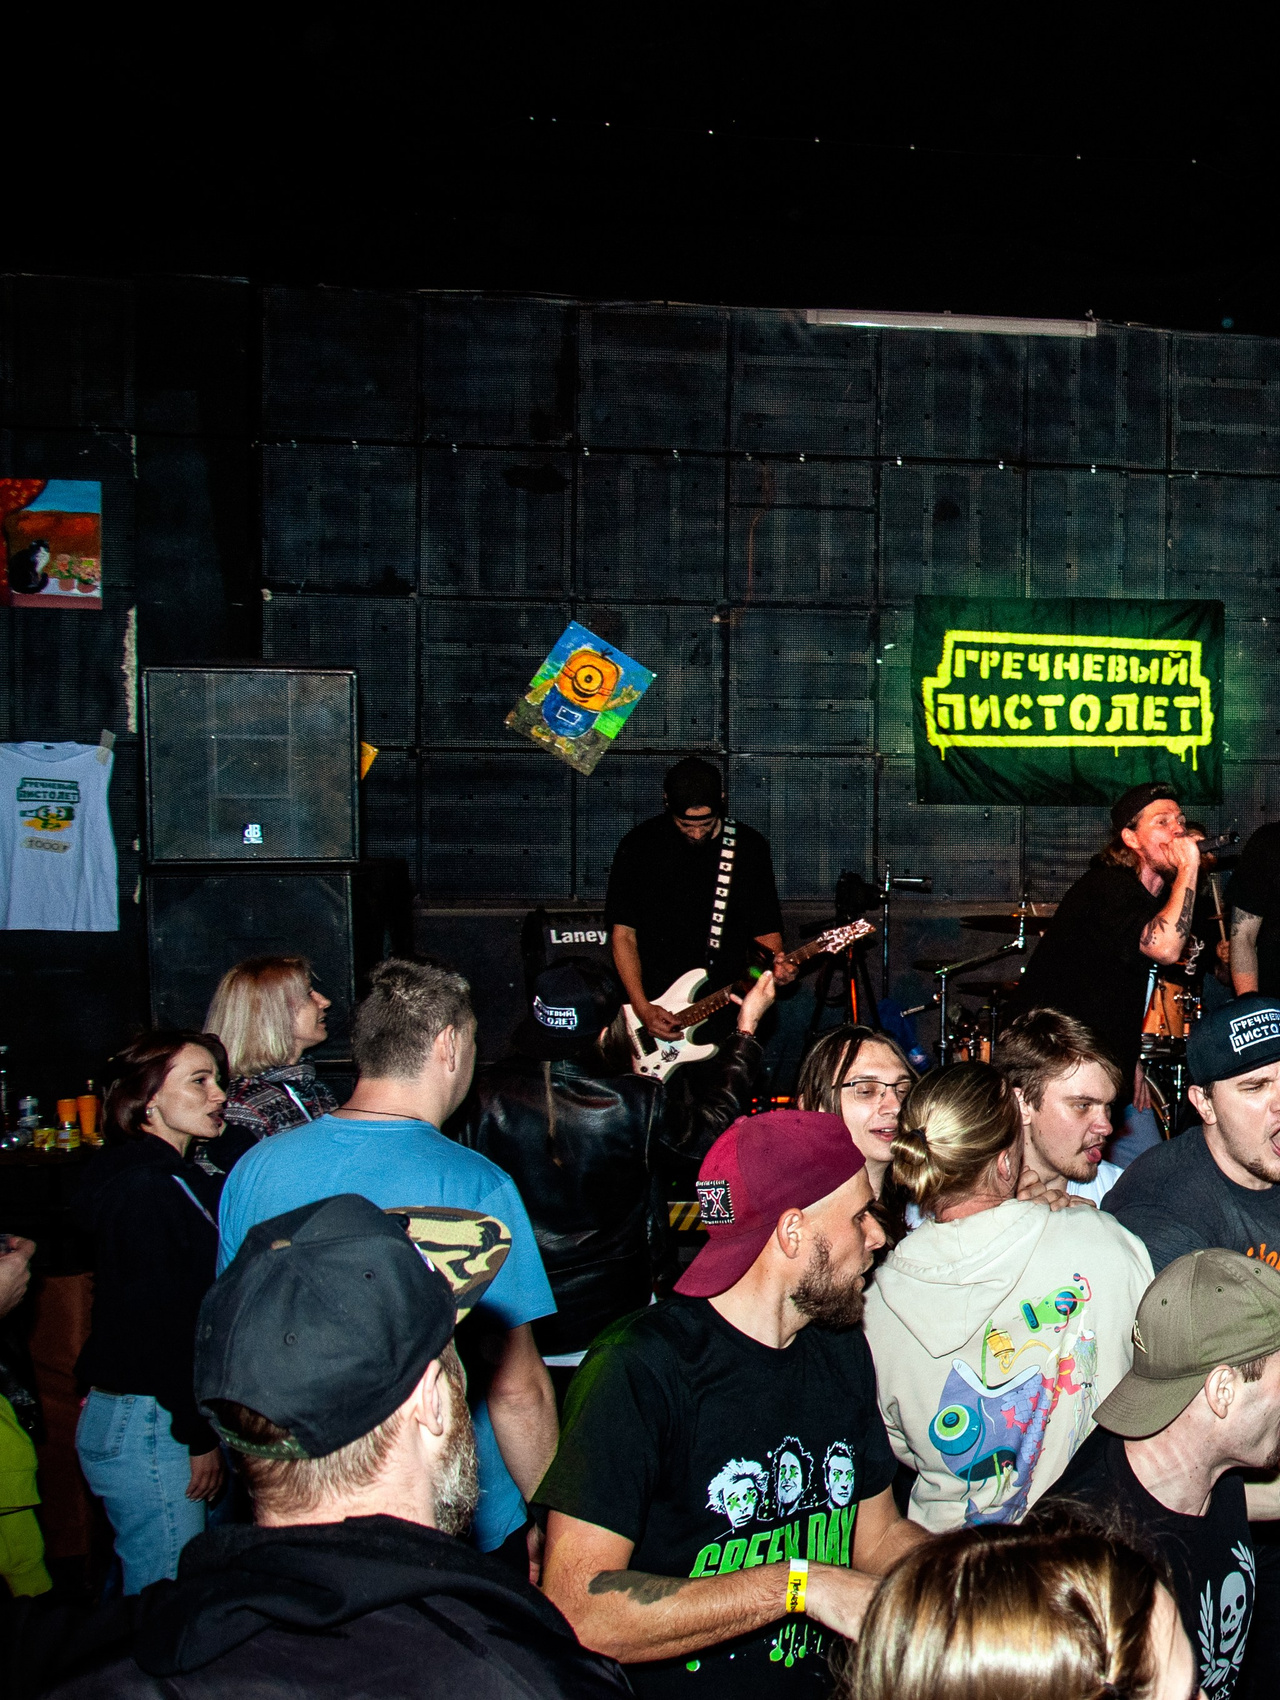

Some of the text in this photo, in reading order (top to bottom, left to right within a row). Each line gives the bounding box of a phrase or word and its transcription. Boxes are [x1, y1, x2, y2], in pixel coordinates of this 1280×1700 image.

[953, 648, 1190, 686] ГРЕЧНЕВЫЙ
[936, 693, 1201, 733] ПИСТОЛЕТ
[550, 929, 608, 945] Laney
[688, 1503, 858, 1579] GREEN DAY
